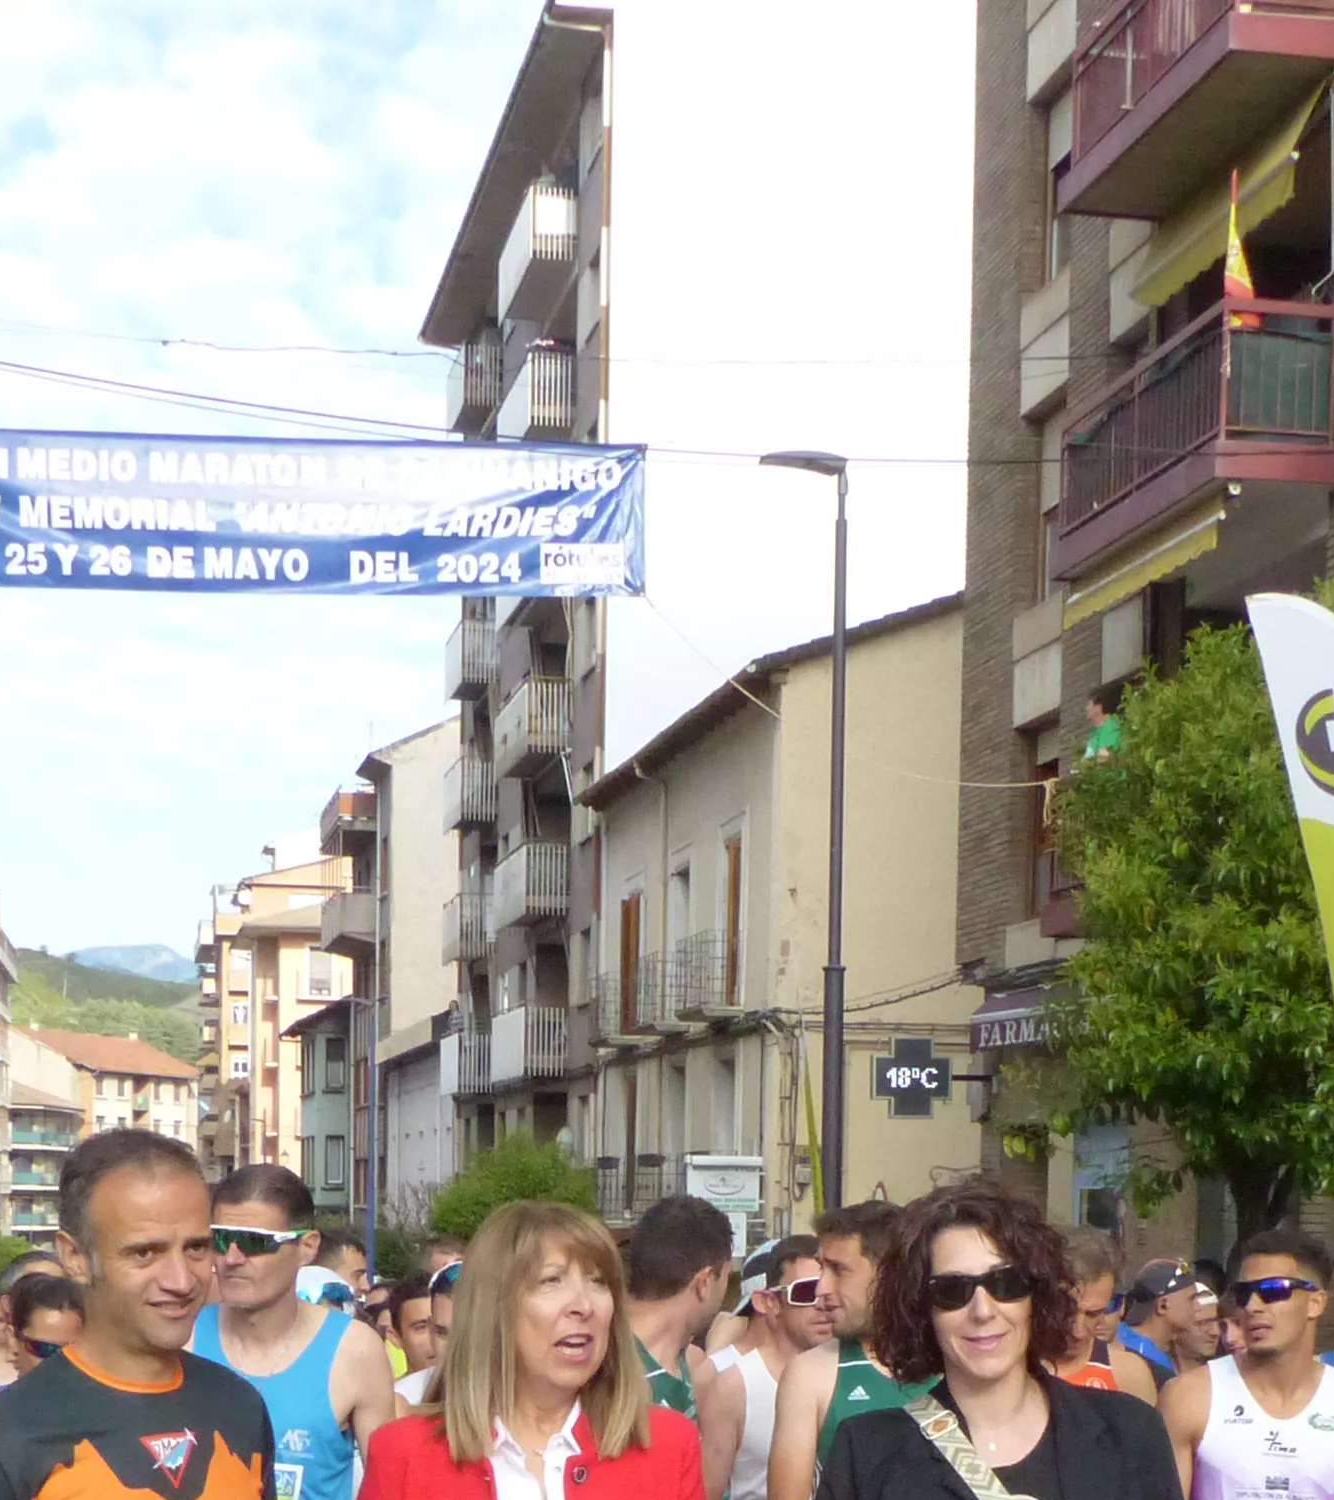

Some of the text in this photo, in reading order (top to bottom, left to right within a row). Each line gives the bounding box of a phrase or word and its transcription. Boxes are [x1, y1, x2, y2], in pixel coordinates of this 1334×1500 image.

[18, 449, 137, 482] MEDIO
[149, 452, 327, 485] MARATON
[19, 495, 216, 531] MEMORIAL
[5, 543, 47, 575] 25
[52, 543, 79, 576] Y
[89, 545, 132, 576] 26
[147, 546, 195, 579] DE
[203, 546, 309, 582] MAYO
[349, 550, 419, 584] DEL
[437, 552, 521, 584] 2024
